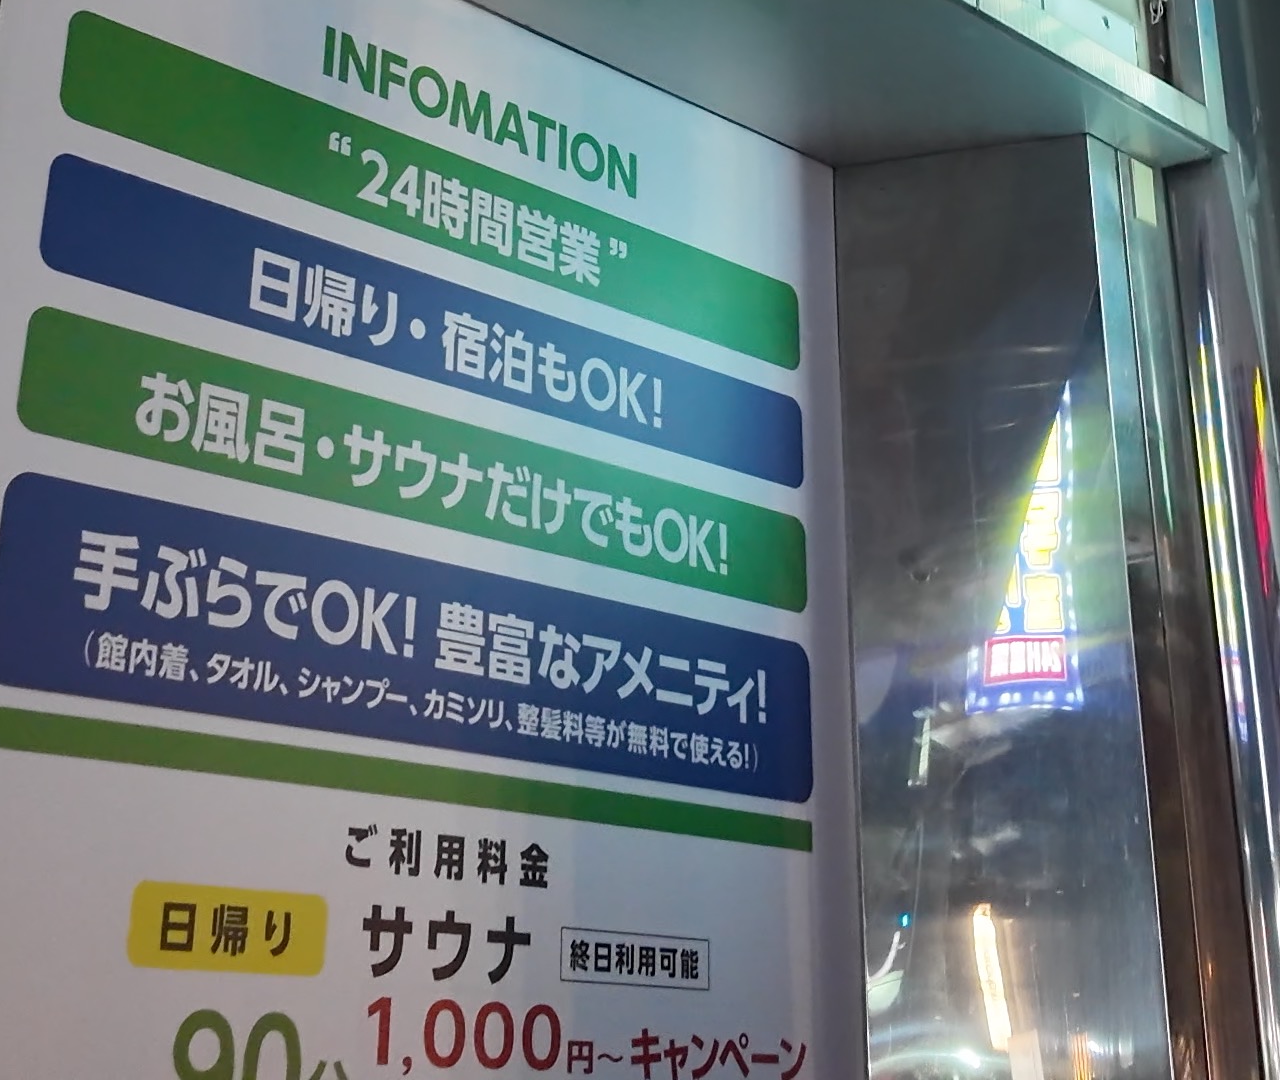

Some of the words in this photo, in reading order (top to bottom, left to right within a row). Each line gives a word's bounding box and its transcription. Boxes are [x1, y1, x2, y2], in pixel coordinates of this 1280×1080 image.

[323, 26, 637, 200] INFOMATION
[344, 823, 551, 890] ご利用料金
[159, 901, 292, 957] 日帰り
[362, 904, 531, 985] サウナ
[569, 938, 700, 980] 終日利用可能
[172, 1008, 350, 1080] 90
